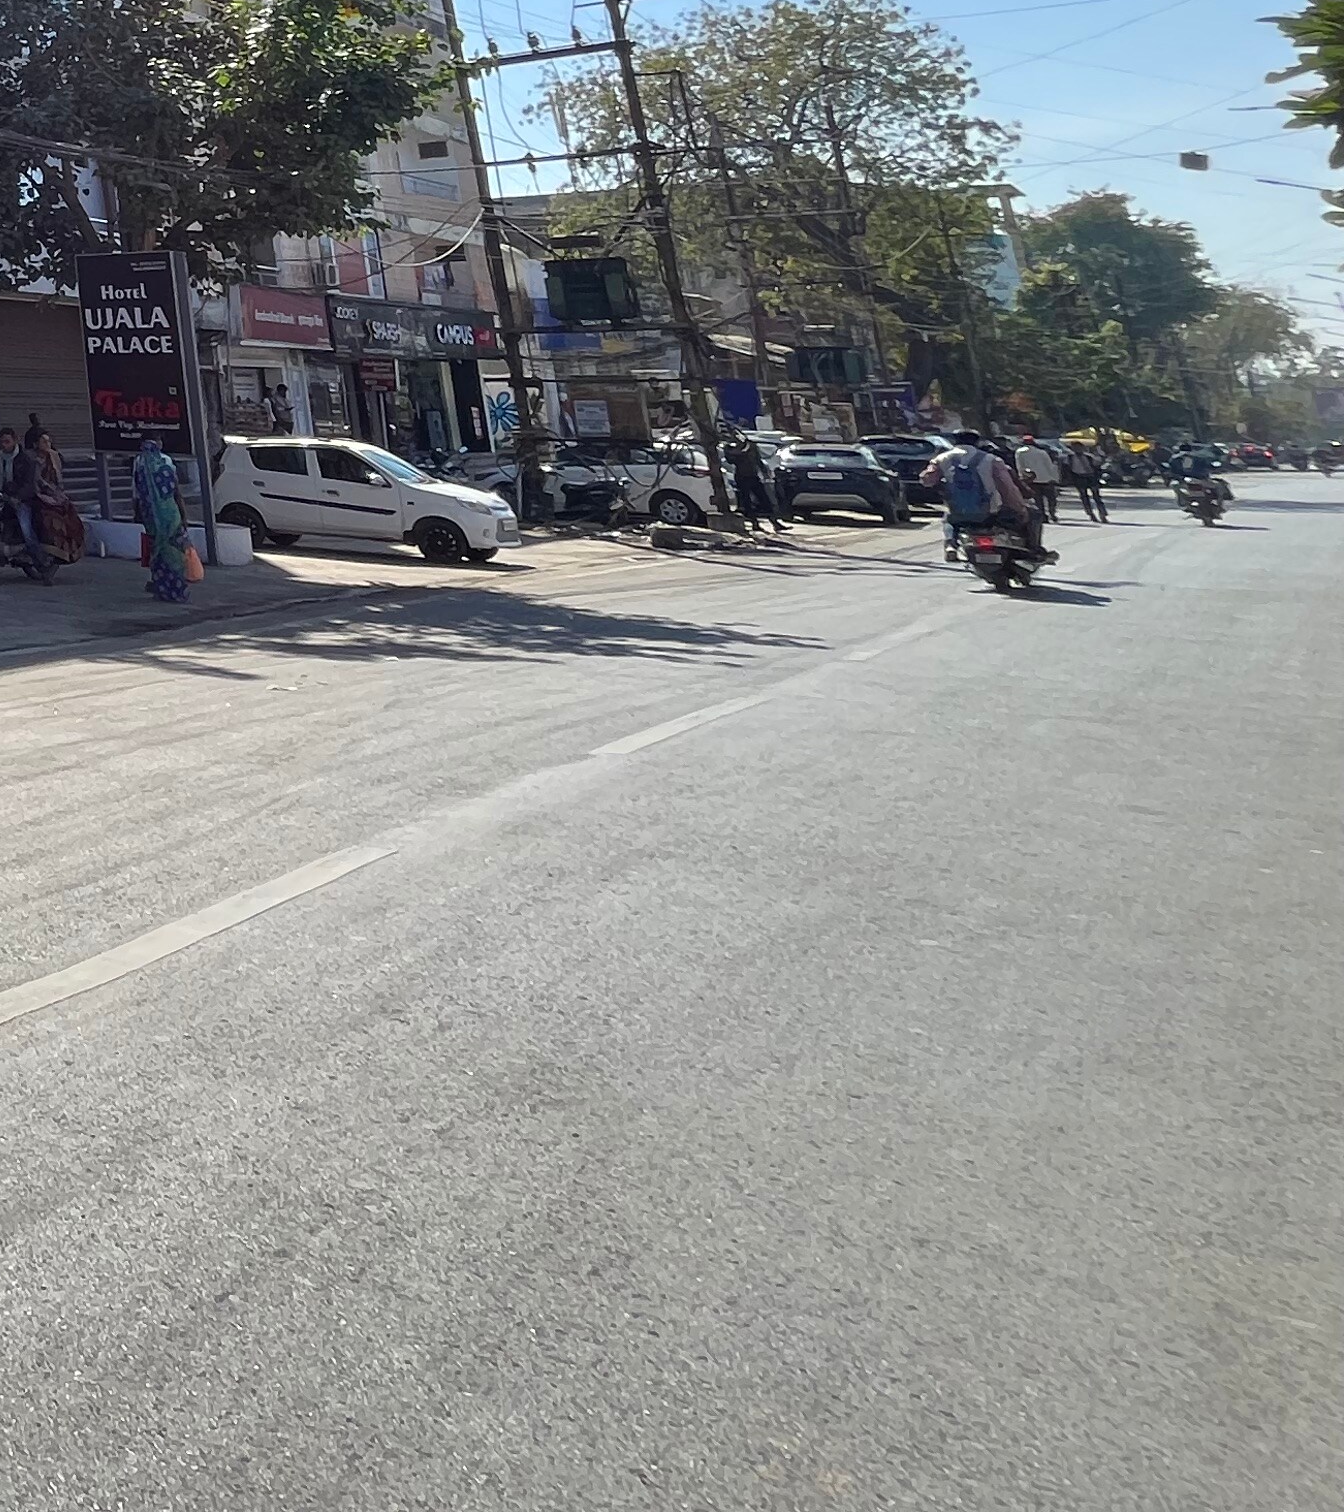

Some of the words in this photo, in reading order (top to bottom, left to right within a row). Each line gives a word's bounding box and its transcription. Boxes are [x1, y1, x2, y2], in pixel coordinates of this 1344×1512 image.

[85, 306, 170, 330] UJALA
[87, 335, 174, 354] PALACE
[436, 323, 474, 346] CAMPUS
[94, 389, 181, 419] Tadka
